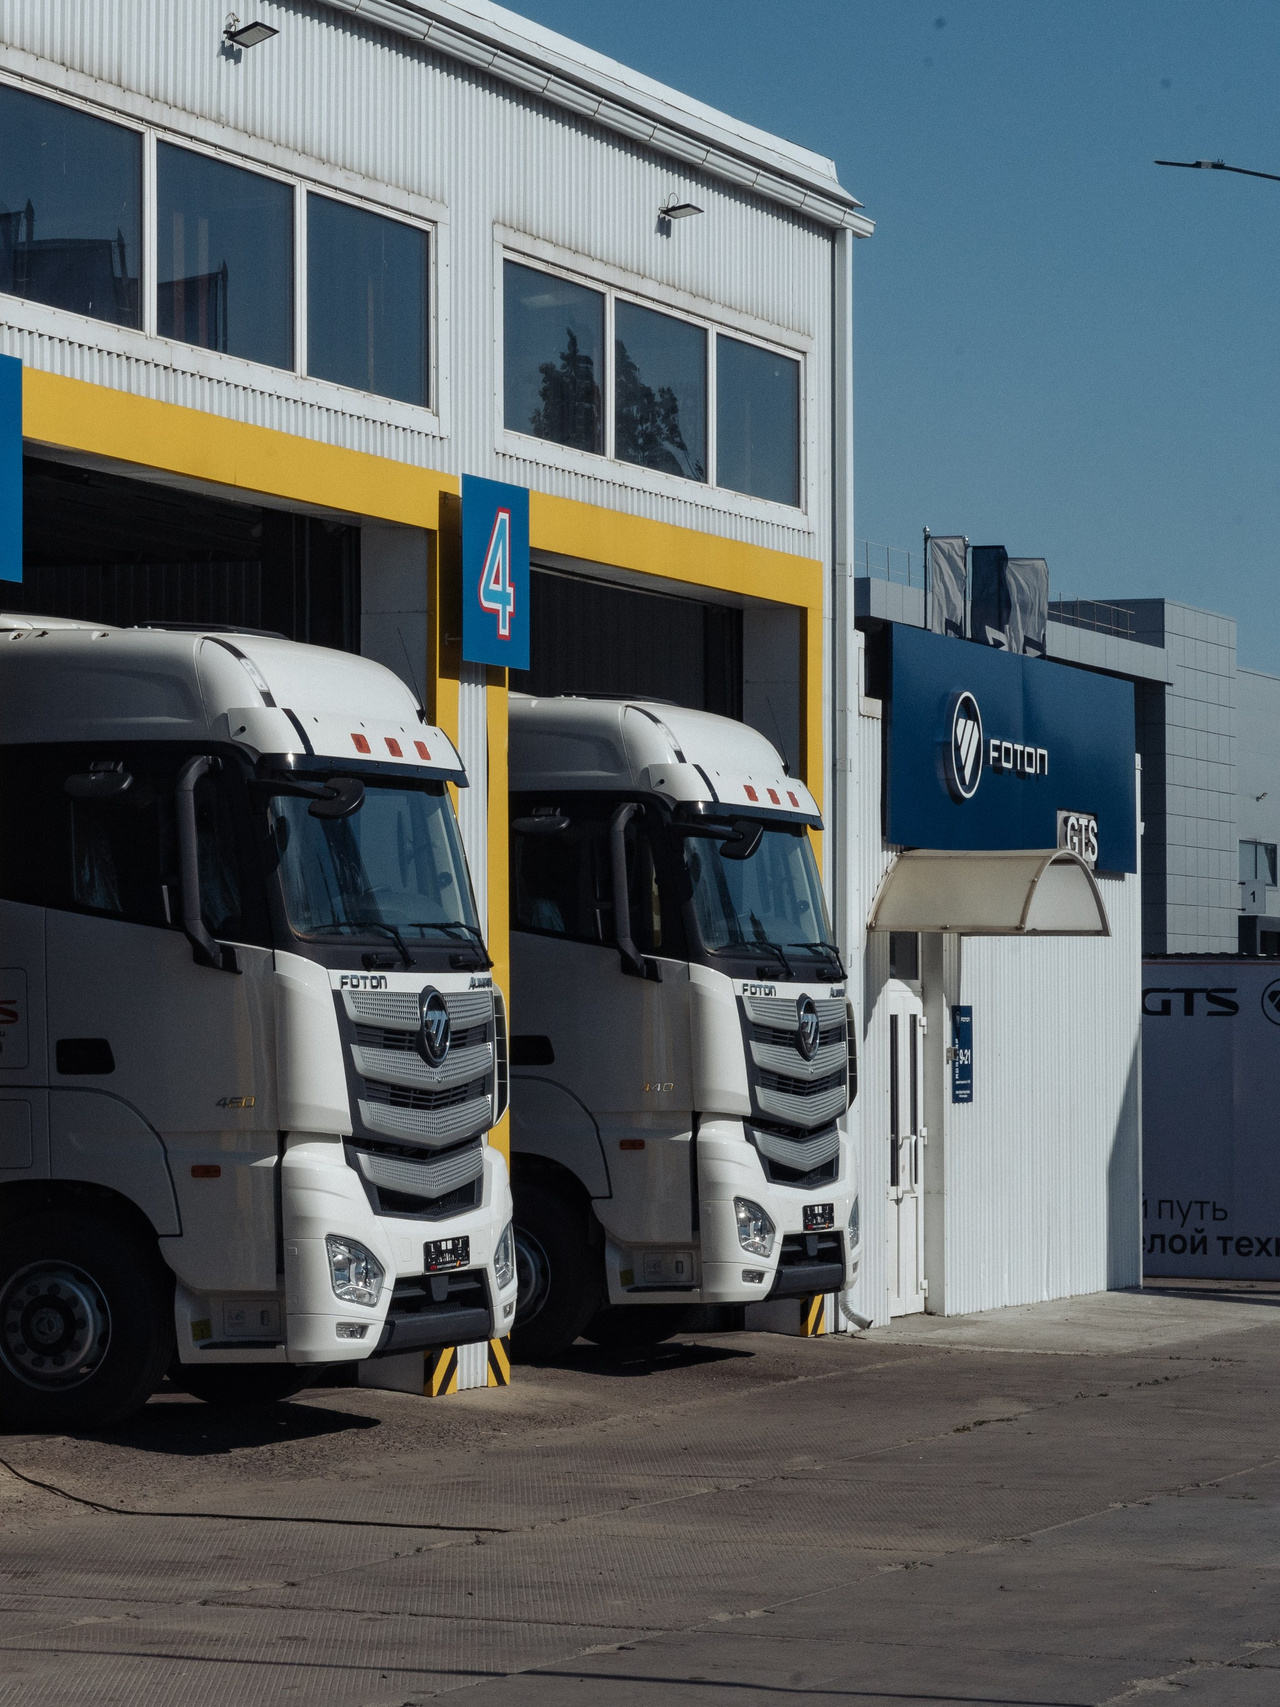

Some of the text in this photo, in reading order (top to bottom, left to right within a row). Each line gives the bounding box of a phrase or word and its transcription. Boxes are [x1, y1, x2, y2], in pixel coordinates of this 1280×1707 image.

[477, 506, 516, 641] 4
[989, 739, 1048, 775] FOTON
[1066, 816, 1098, 862] GTS
[1250, 890, 1256, 903] 1
[339, 974, 388, 989] FOTON
[742, 983, 777, 997] FOTON
[1141, 987, 1239, 1016] GTS
[1158, 1199, 1228, 1228] путь
